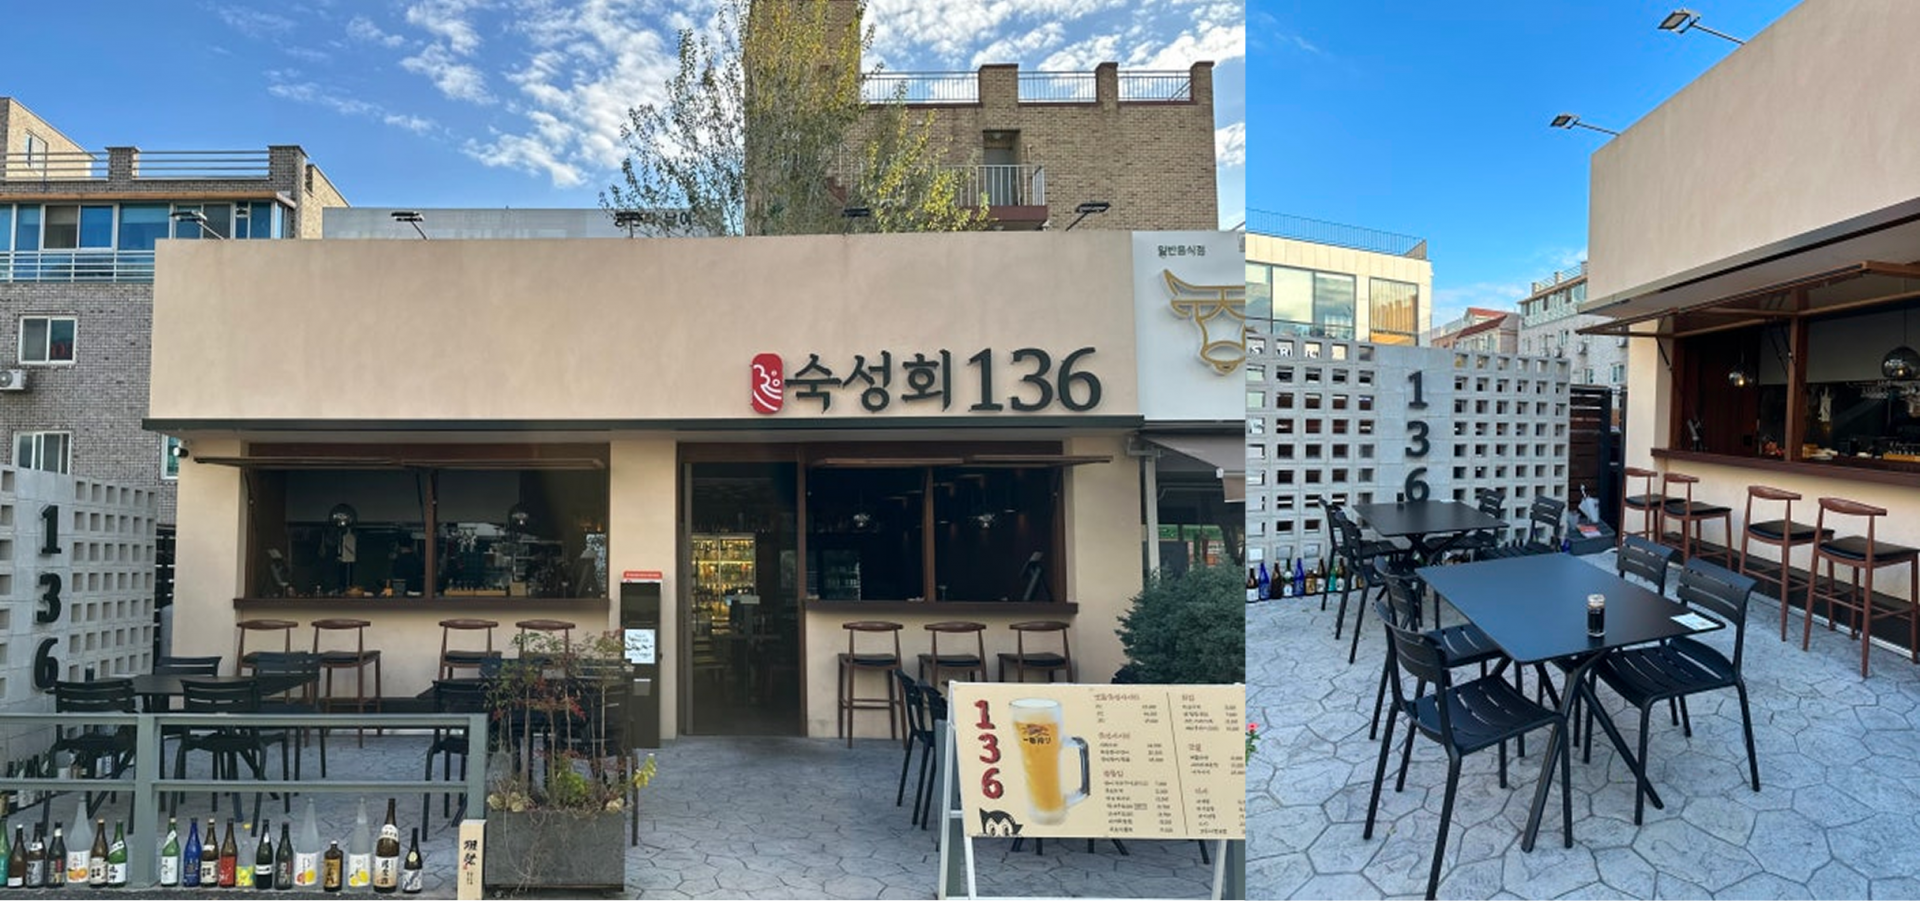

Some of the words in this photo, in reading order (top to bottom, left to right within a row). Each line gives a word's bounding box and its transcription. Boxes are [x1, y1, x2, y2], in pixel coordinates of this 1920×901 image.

[1157, 245, 1206, 258] 일반음식점
[784, 349, 951, 414] 숙성회
[967, 347, 1103, 413] 136
[1404, 370, 1431, 501] 136
[34, 504, 62, 689] 136
[974, 699, 1005, 799] 136
